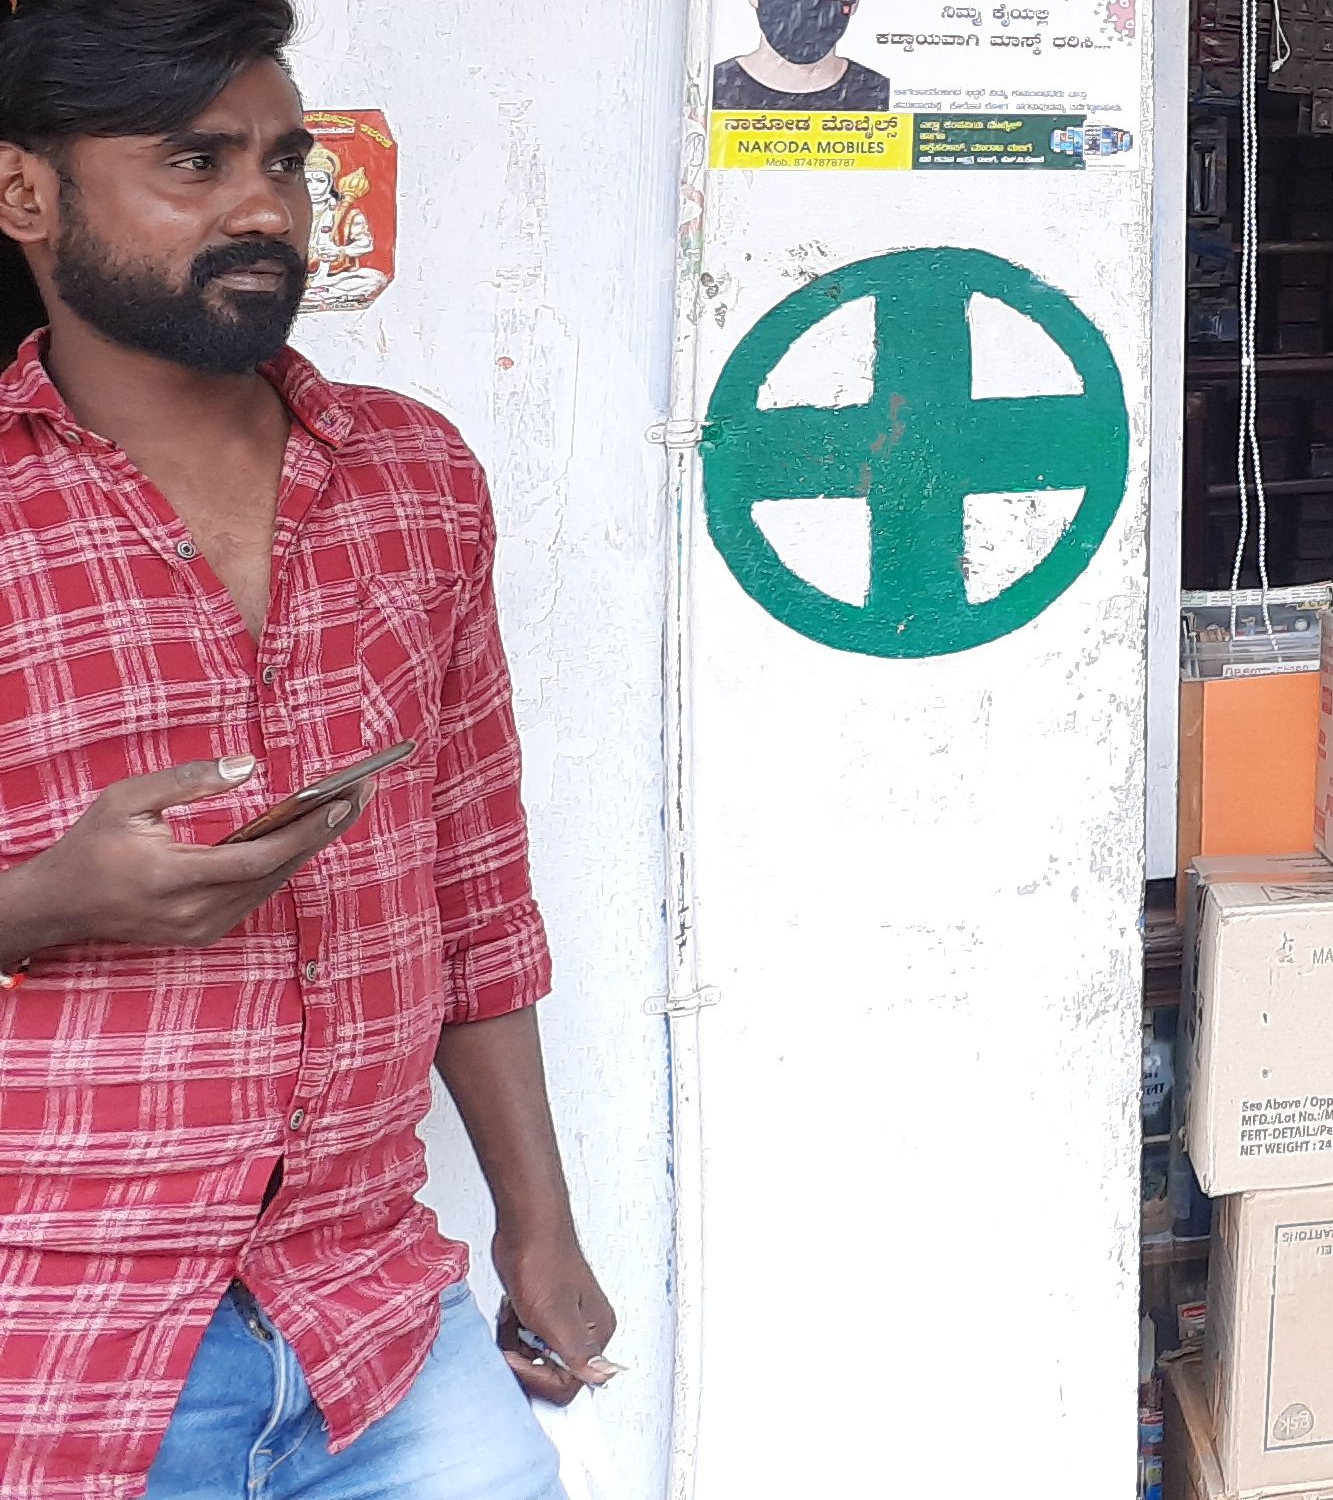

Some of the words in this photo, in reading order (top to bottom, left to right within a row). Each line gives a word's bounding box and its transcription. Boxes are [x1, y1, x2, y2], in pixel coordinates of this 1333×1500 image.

[940, 5, 982, 26] ನಿಮ್ಮ
[724, 114, 810, 131] ನಾಕೋಡ
[737, 140, 812, 154] NAKODA
[816, 140, 884, 154] MOBILES
[1240, 1099, 1262, 1112] See
[1264, 1096, 1300, 1110] Above
[1239, 1143, 1262, 1156] NET
[1264, 1140, 1310, 1154] WEIGHT
[1317, 1138, 1332, 1150] 24
[1280, 1410, 1310, 1436] gsk
